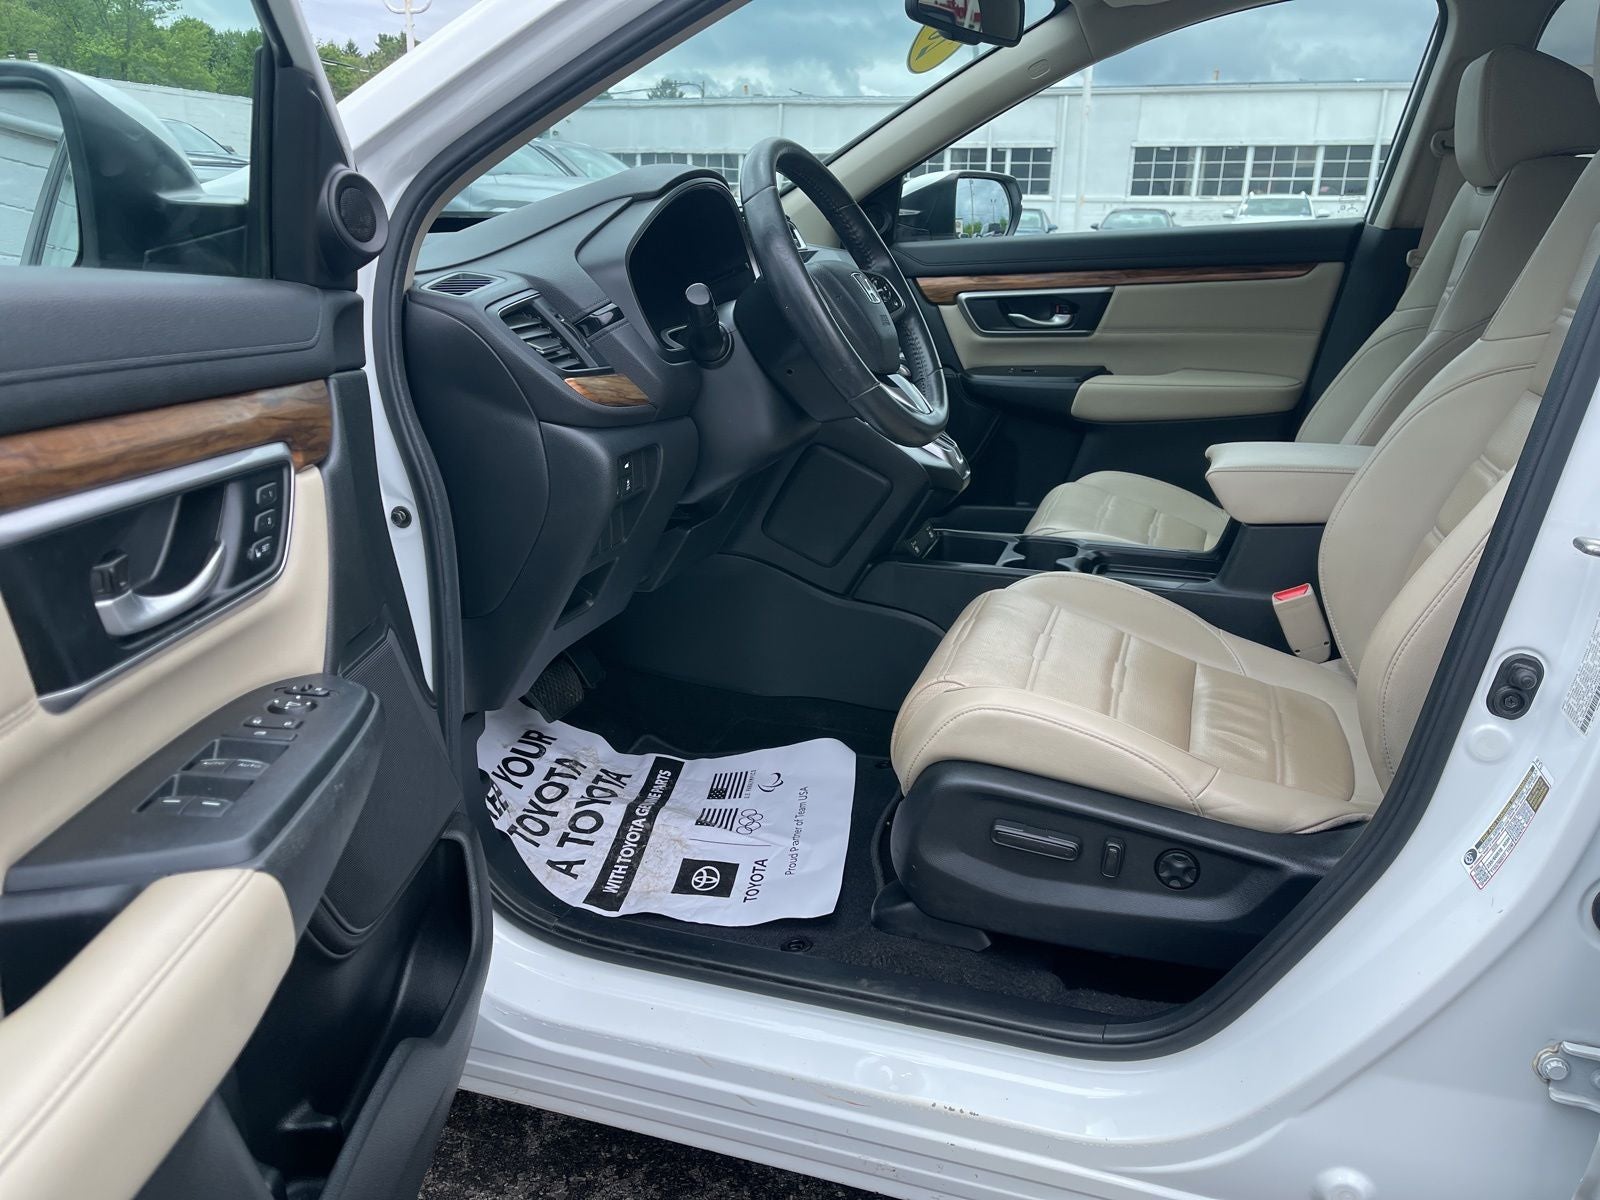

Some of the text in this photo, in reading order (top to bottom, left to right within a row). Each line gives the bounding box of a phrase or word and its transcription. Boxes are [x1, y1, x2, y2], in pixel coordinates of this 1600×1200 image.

[491, 729, 558, 790] YOUR
[507, 757, 587, 848] TOYOTA
[794, 802, 808, 820] Team
[797, 786, 809, 802] USA
[546, 768, 633, 880] A TOYOTA
[602, 864, 629, 895] WITH
[617, 817, 646, 863] TOYOTA
[650, 769, 673, 796] PARTS
[789, 827, 803, 853] Partner
[743, 858, 769, 903] TOYOTA
[784, 853, 799, 876] Proud
